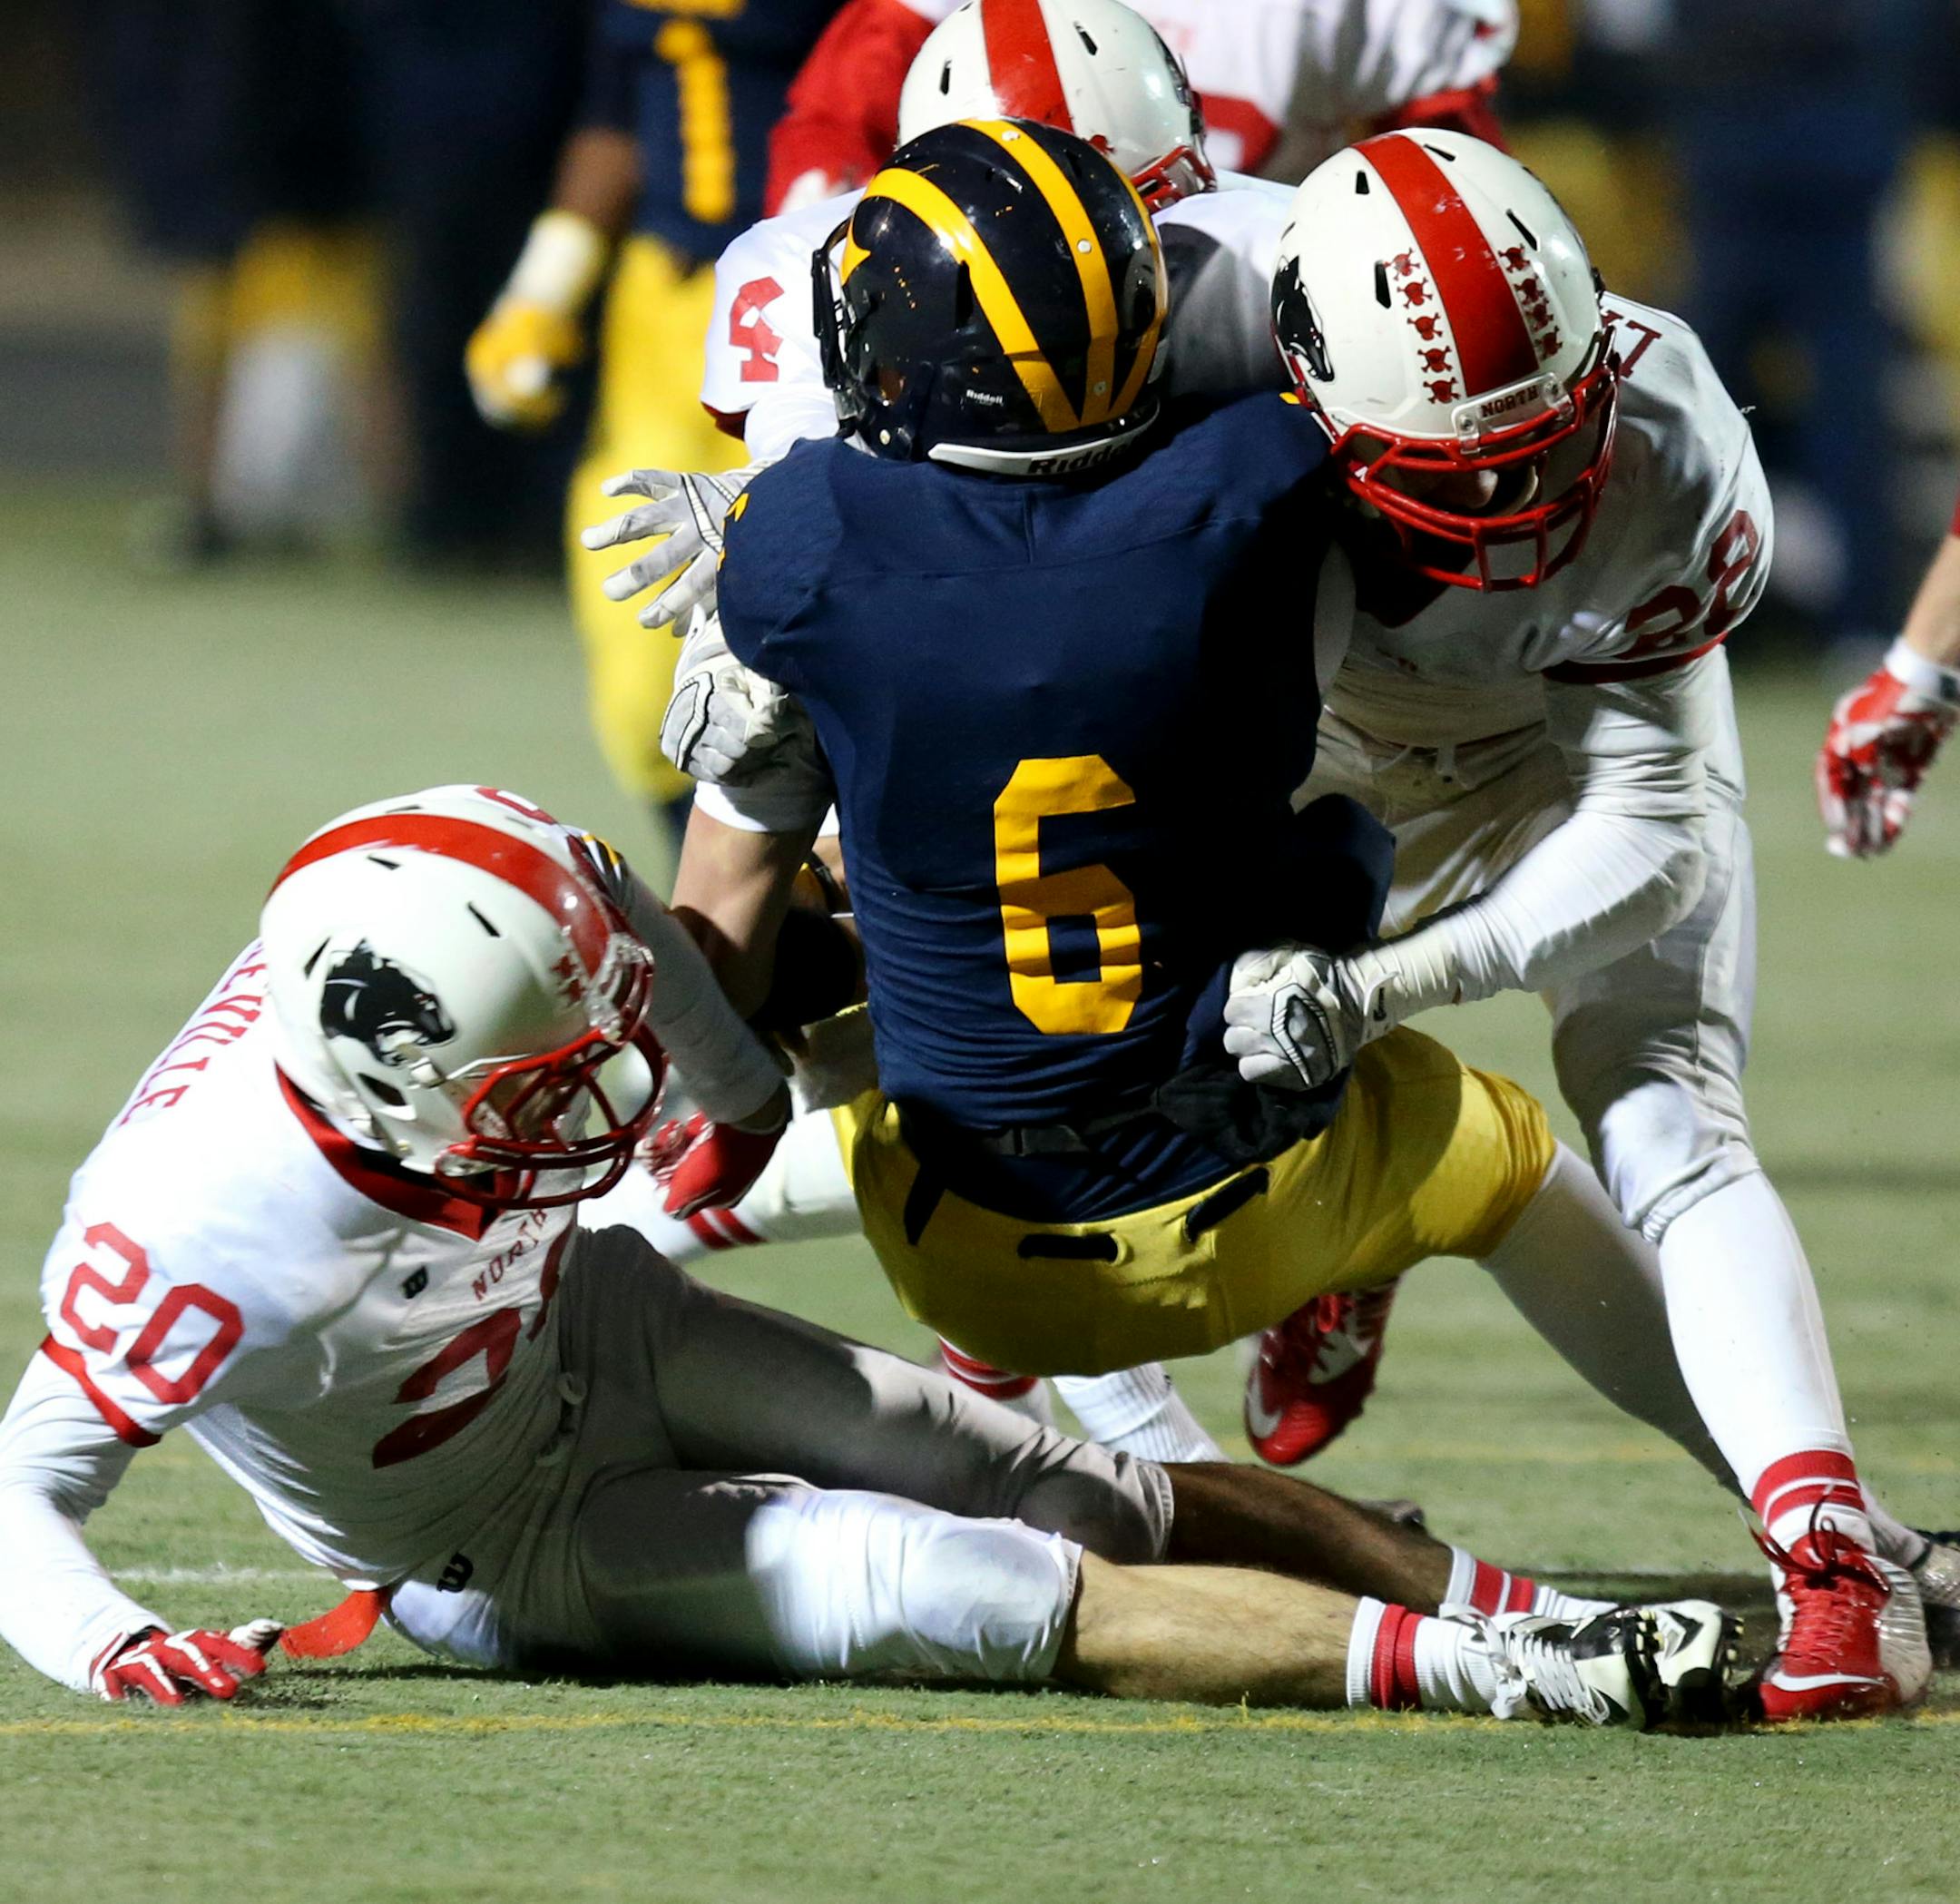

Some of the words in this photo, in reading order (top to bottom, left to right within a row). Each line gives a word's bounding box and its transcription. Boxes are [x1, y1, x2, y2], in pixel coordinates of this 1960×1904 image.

[965, 388, 1004, 405] Riddell
[1481, 384, 1540, 417] NORTH
[993, 754, 1143, 1035] 6
[60, 1221, 247, 1404] 20
